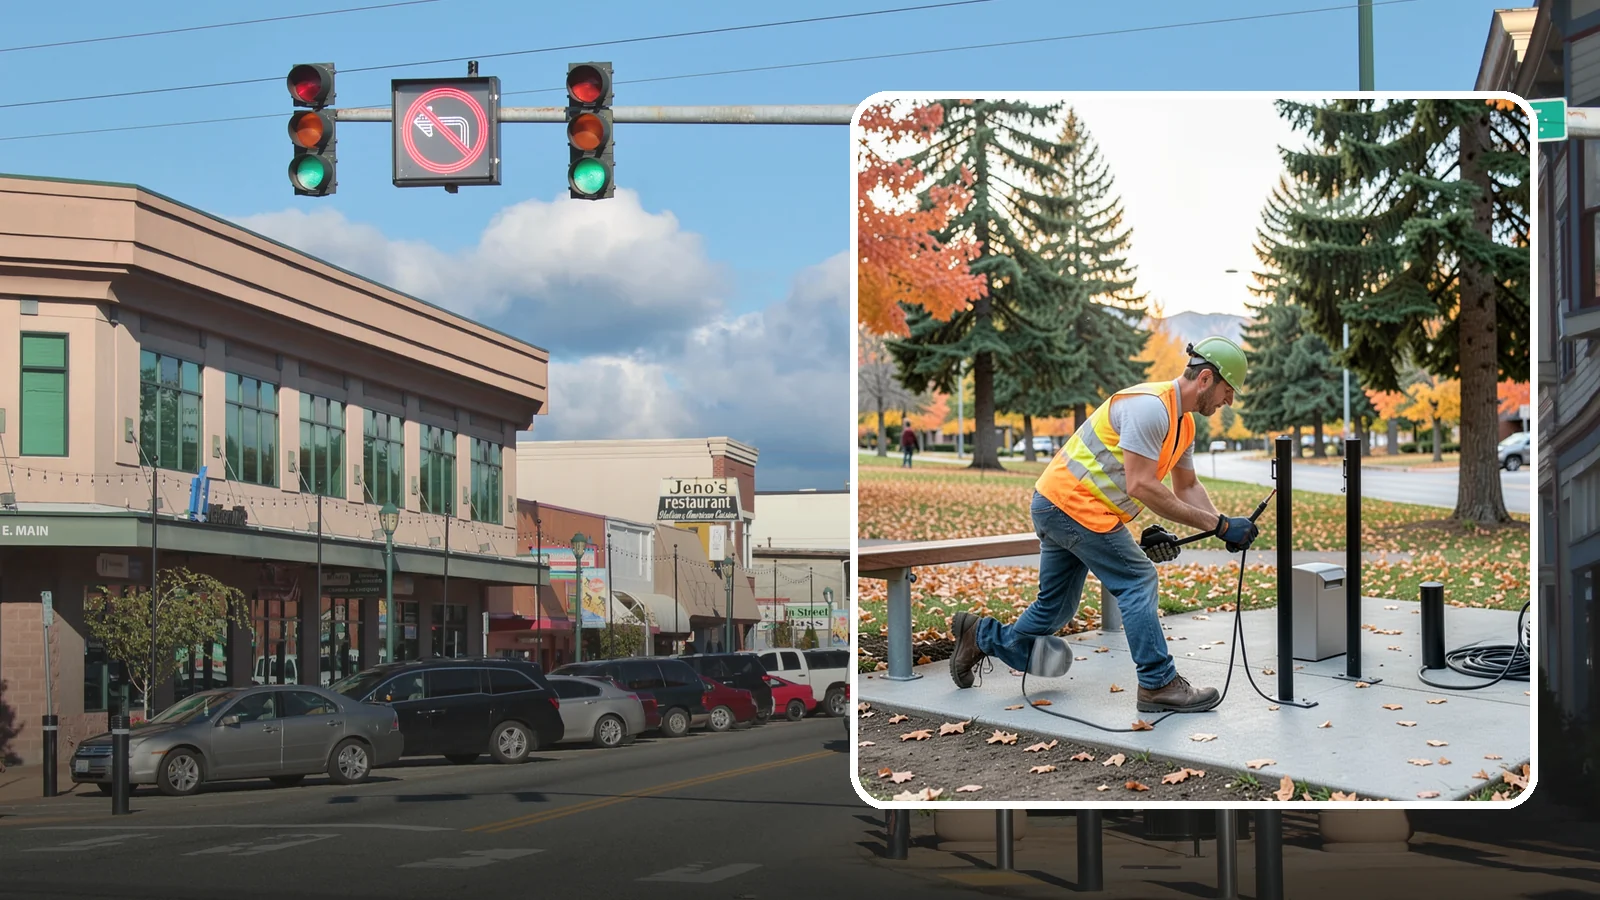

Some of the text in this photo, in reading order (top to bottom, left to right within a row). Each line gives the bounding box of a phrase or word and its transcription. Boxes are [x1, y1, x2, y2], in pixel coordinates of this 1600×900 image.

[669, 480, 728, 494] Jeno's
[665, 496, 731, 509] restaurant
[686, 510, 715, 520] American
[715, 509, 738, 520] Cuisine
[2, 525, 49, 537] E. MAIN
[797, 607, 829, 617] Street
